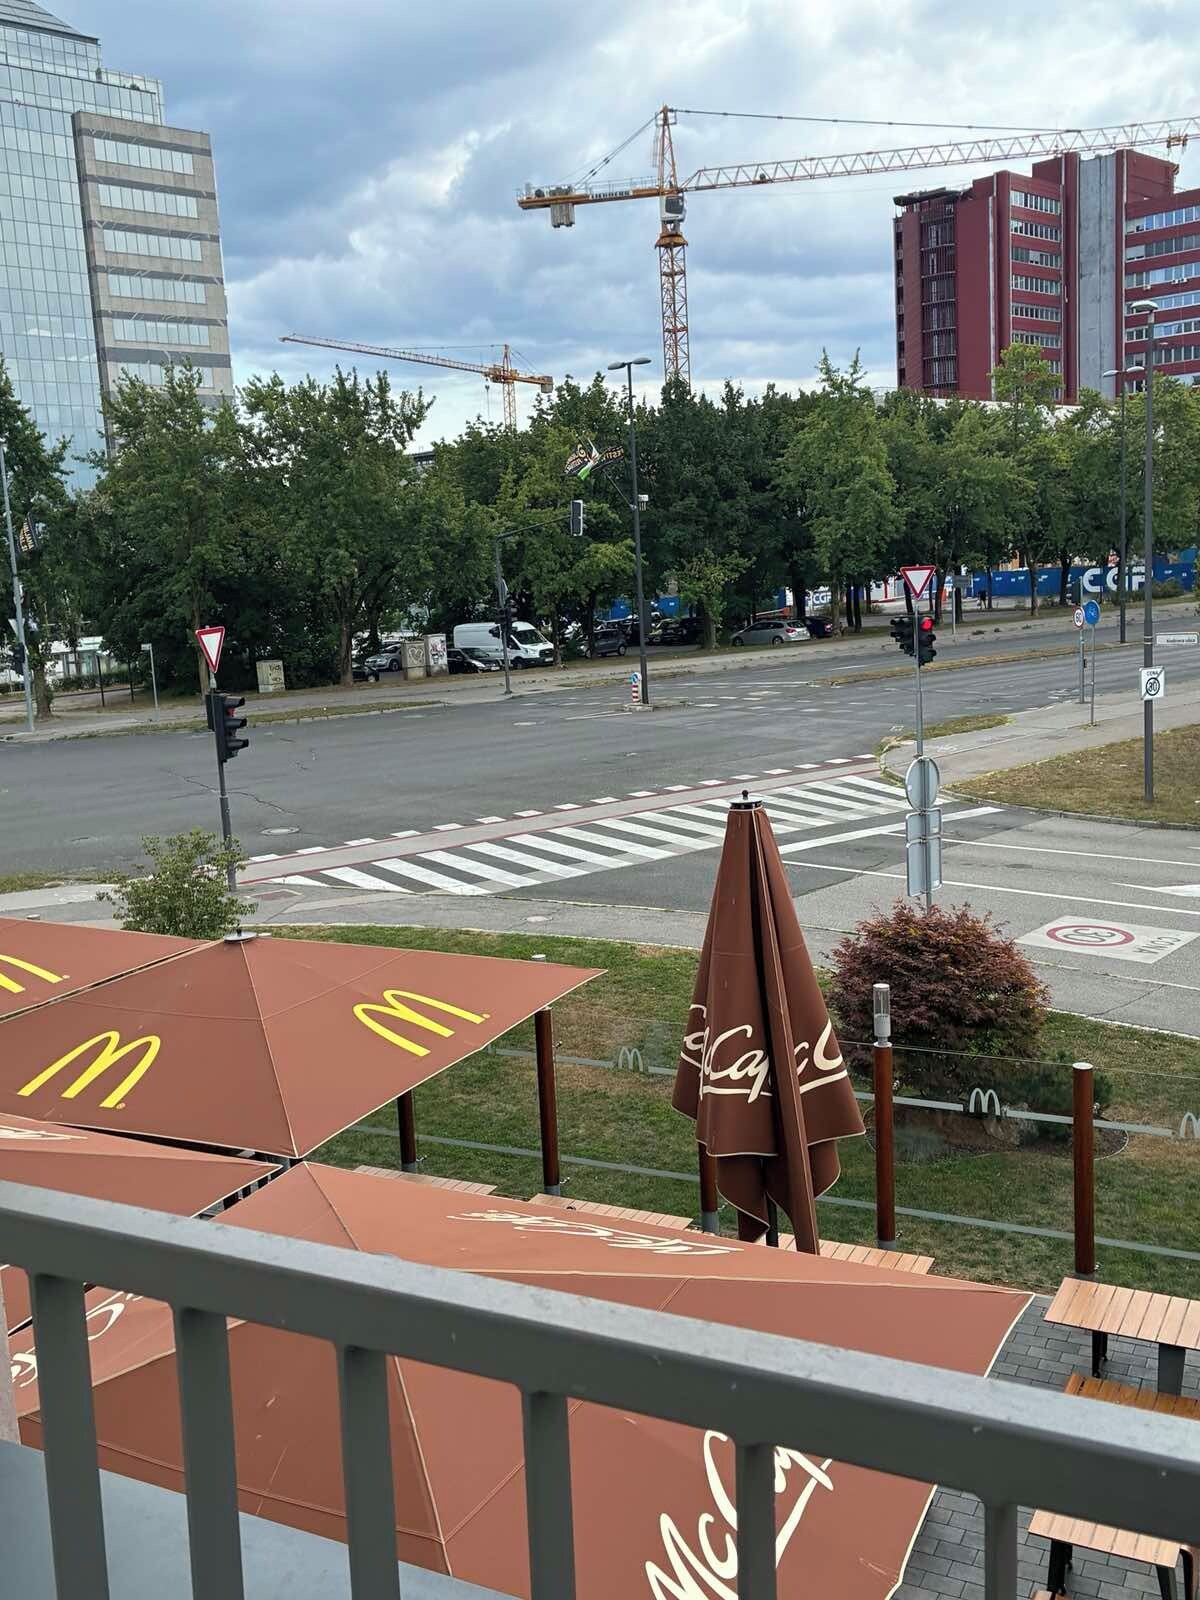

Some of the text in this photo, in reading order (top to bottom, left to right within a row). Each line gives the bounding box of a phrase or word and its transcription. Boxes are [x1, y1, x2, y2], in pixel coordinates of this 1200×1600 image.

[1148, 680, 1159, 692] 30
[1062, 928, 1116, 943] 30
[1134, 936, 1182, 954] CONA
[353, 989, 485, 1056] M
[17, 1031, 160, 1108] M
